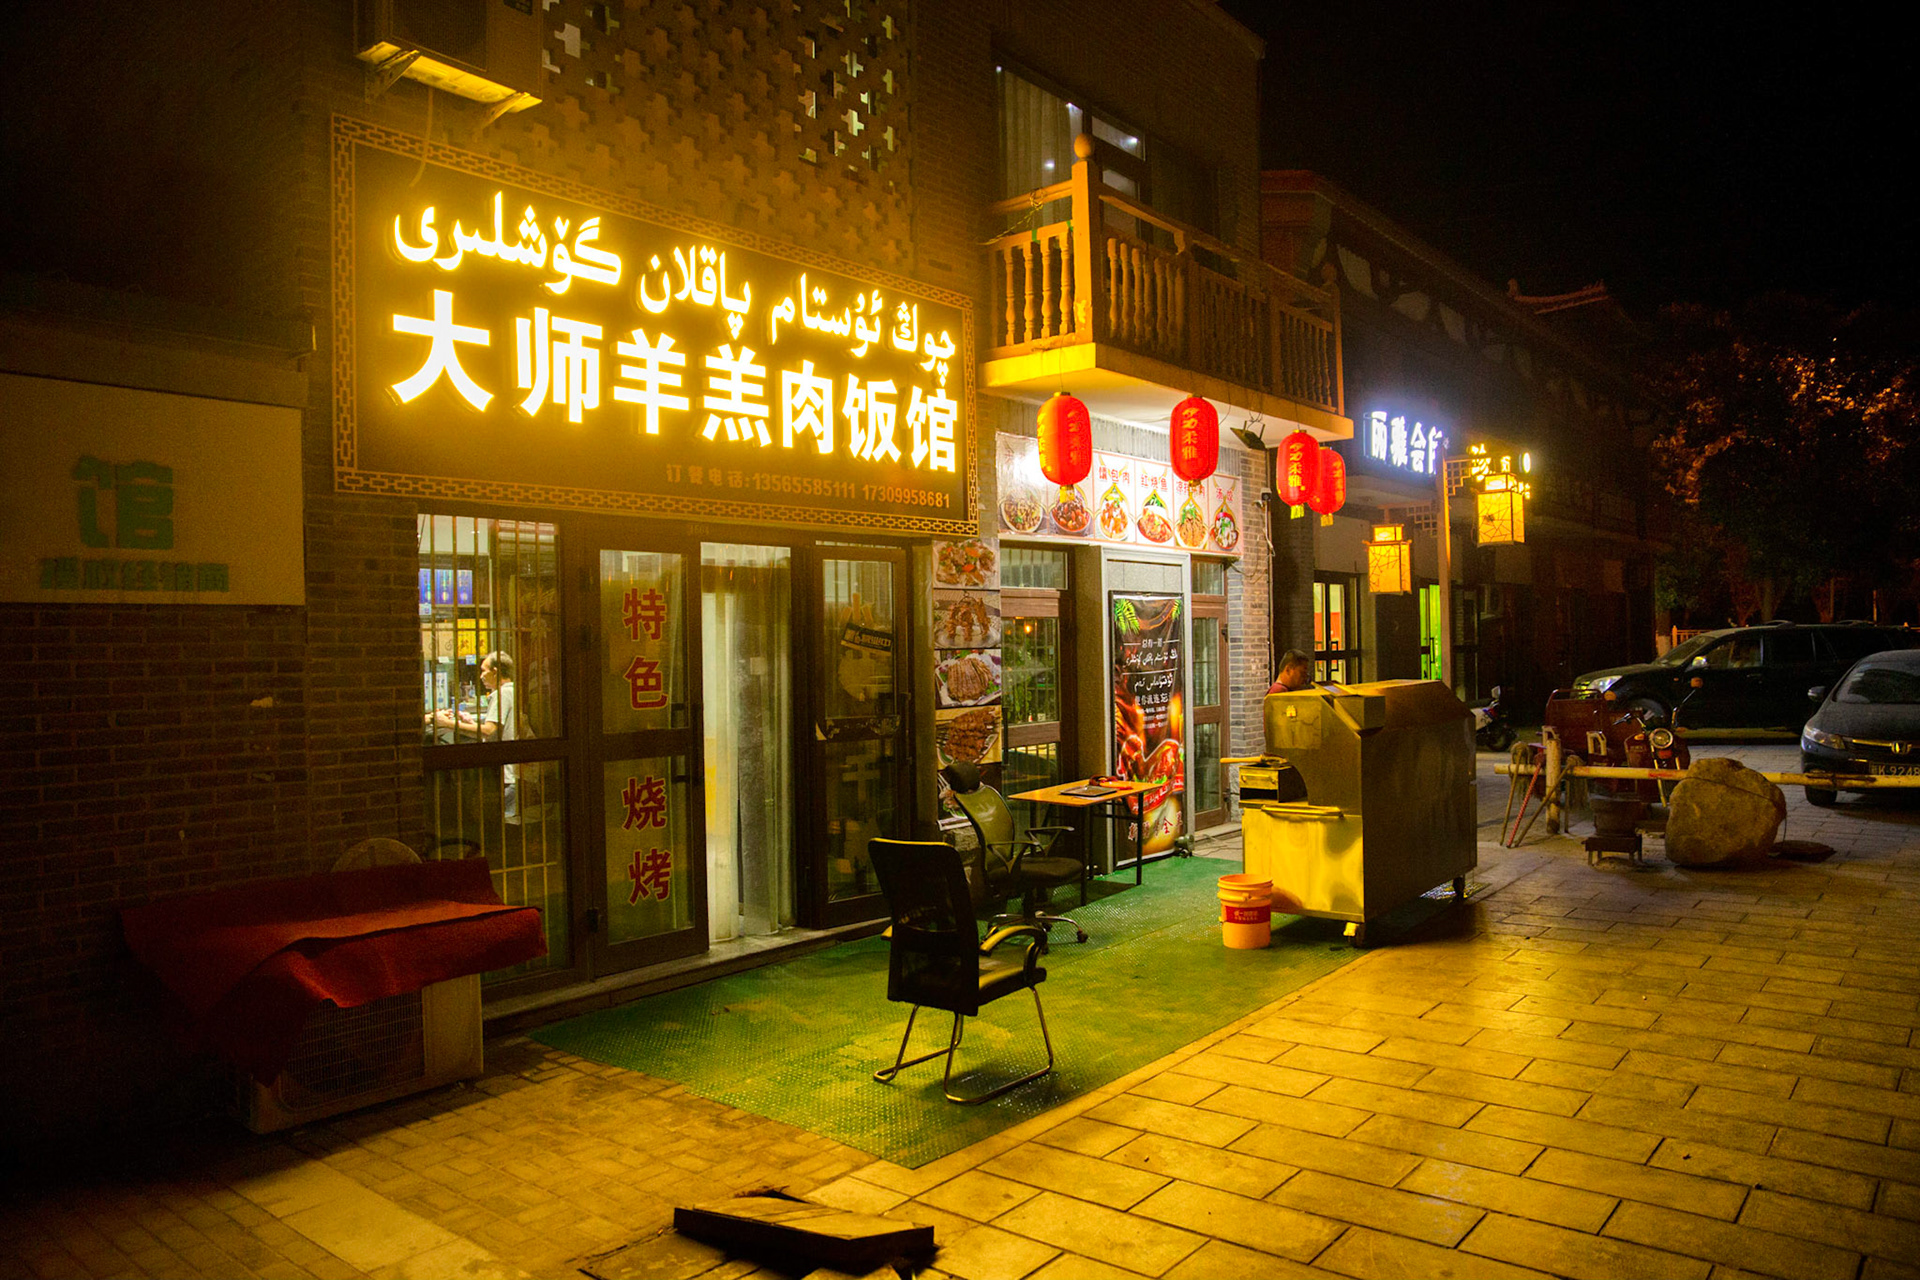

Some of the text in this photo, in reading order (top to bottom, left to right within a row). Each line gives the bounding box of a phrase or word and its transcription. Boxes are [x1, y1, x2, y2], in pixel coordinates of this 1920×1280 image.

[641, 245, 751, 340] پاقلان
[392, 290, 958, 473] 大师羊羔肉饭馆
[73, 454, 174, 550] 馆
[862, 485, 950, 508] 17309958681
[621, 588, 672, 905] 特色 烧烤
